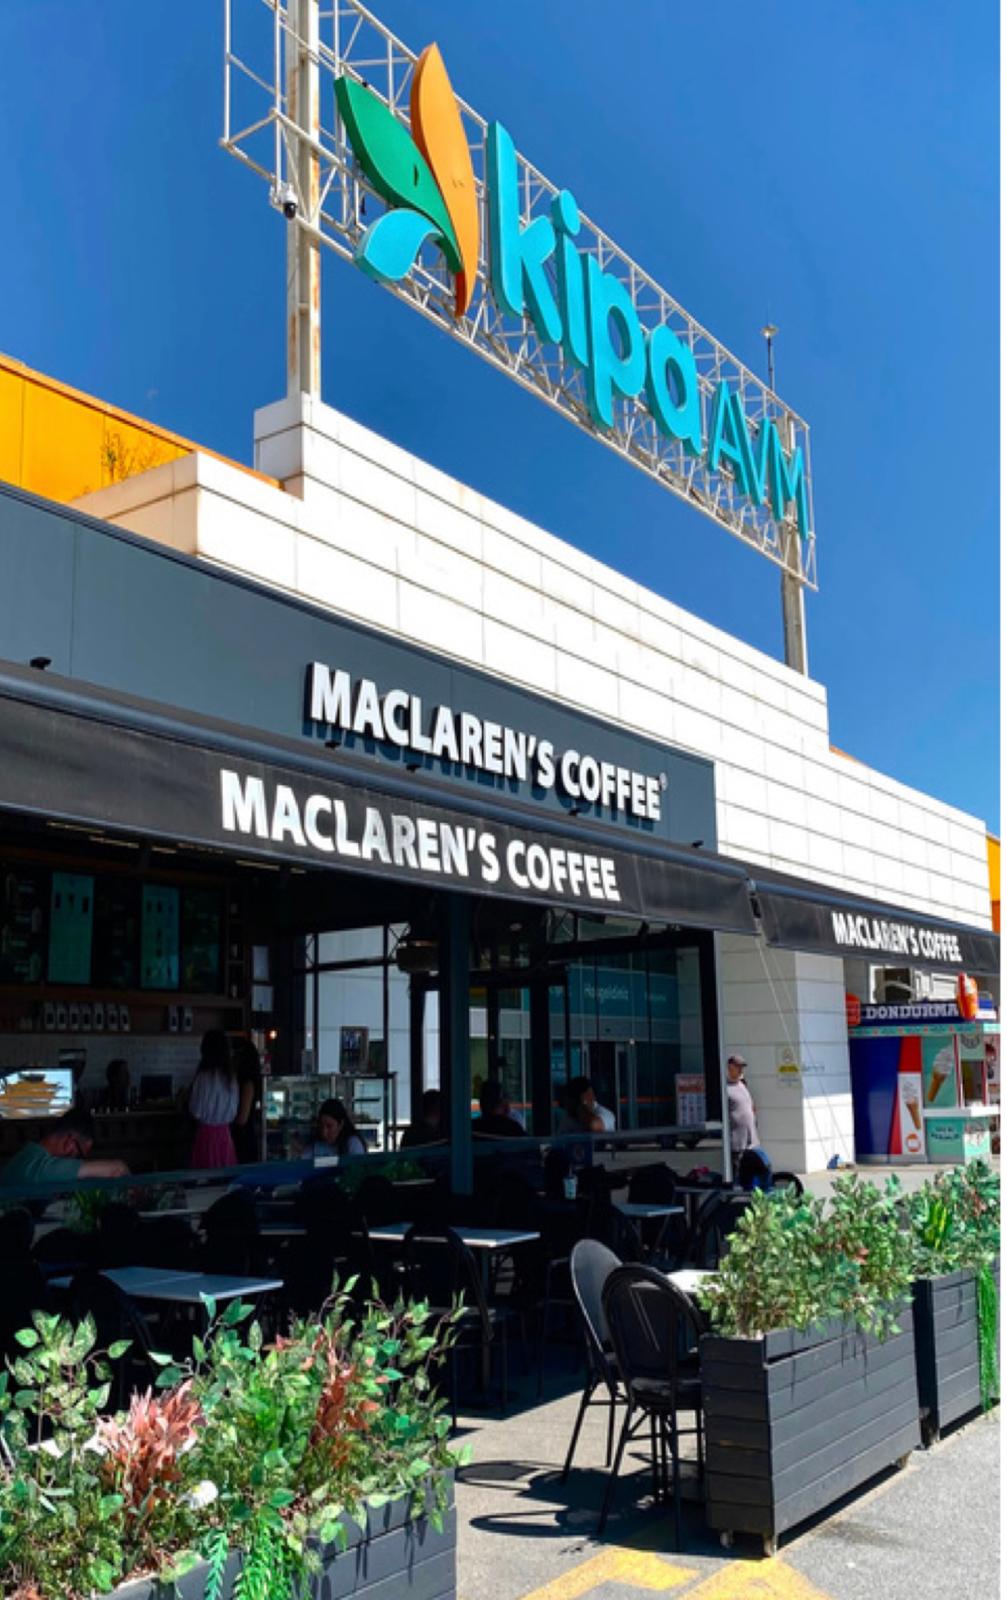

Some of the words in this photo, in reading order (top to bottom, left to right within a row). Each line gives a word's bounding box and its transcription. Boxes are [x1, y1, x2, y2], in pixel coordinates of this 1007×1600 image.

[487, 120, 702, 457] kipa
[708, 379, 808, 540] AVM
[308, 661, 556, 789] MACLAREN'S
[219, 768, 501, 883] MACLAREN'S
[505, 839, 621, 902] COFFEE
[832, 911, 919, 957] MACLAREN'S
[919, 929, 963, 962] COFFEE
[866, 1004, 959, 1019] DONDURMA
